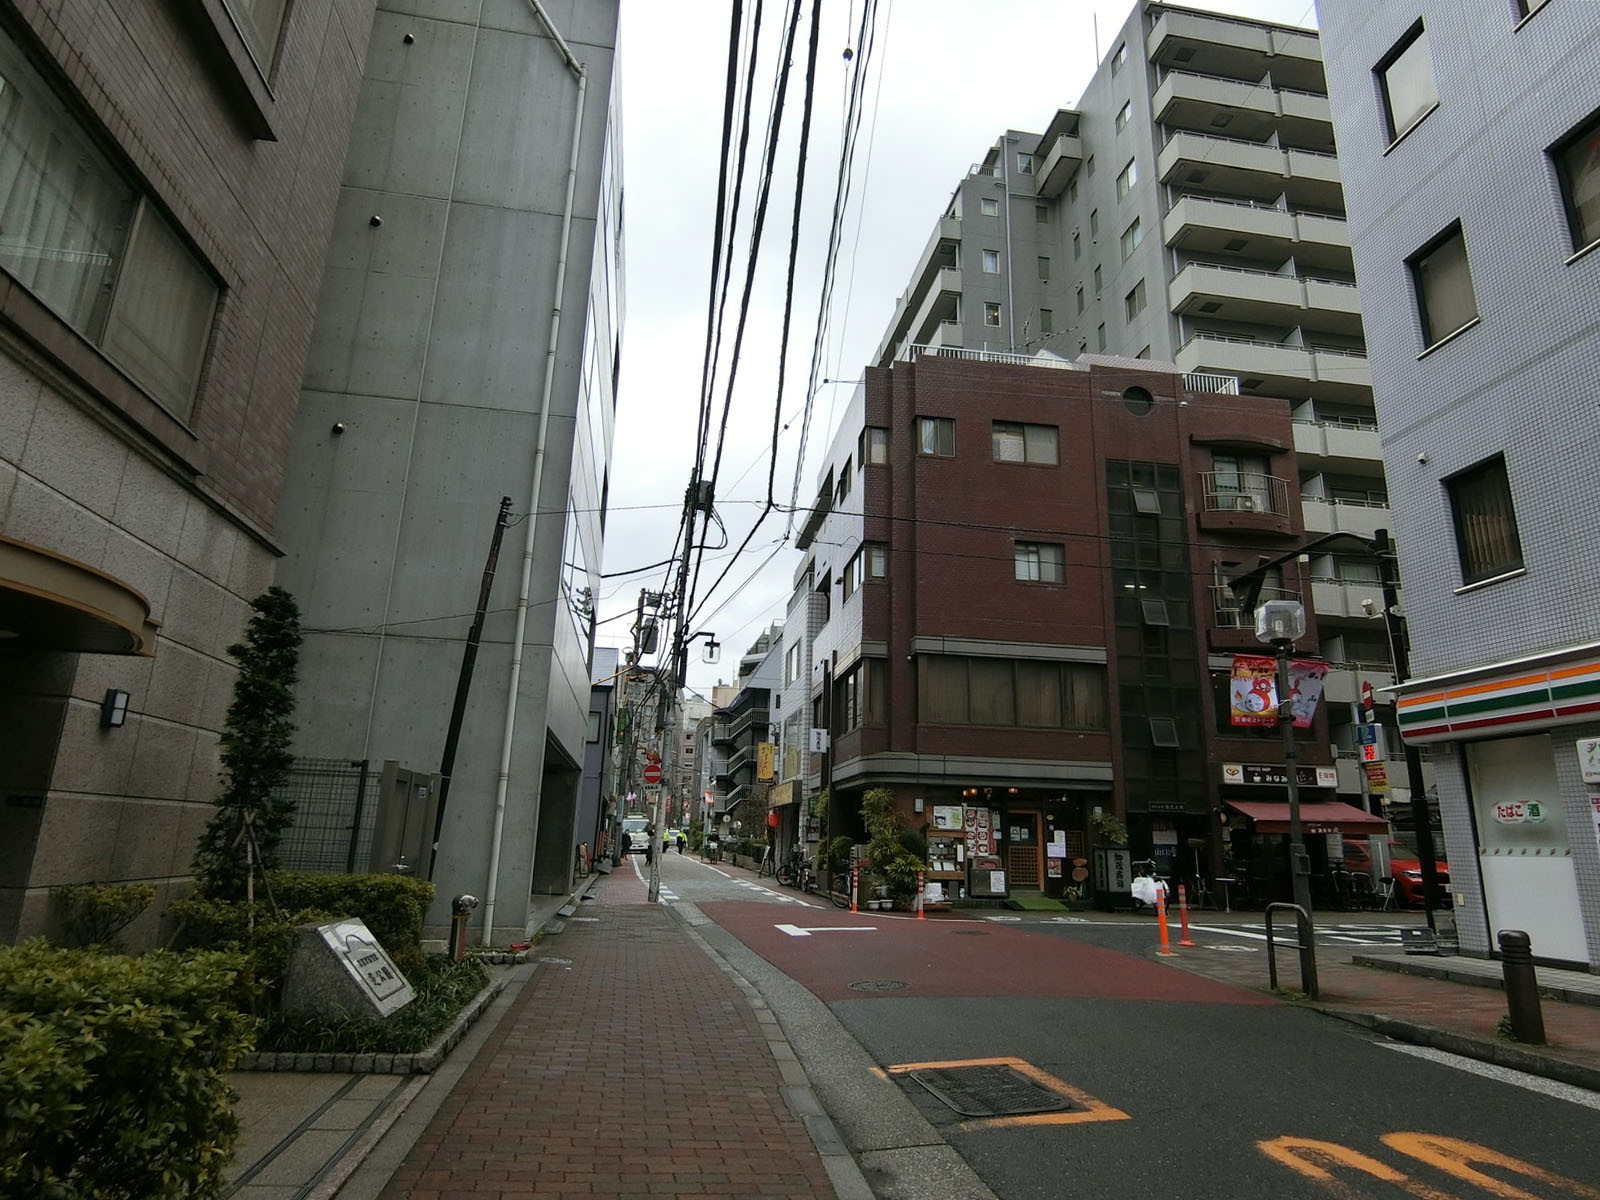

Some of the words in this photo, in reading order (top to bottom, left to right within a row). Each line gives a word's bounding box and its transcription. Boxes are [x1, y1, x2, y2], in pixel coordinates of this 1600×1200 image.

[1496, 804, 1524, 818] たばこ
[1527, 803, 1541, 817] 酒
